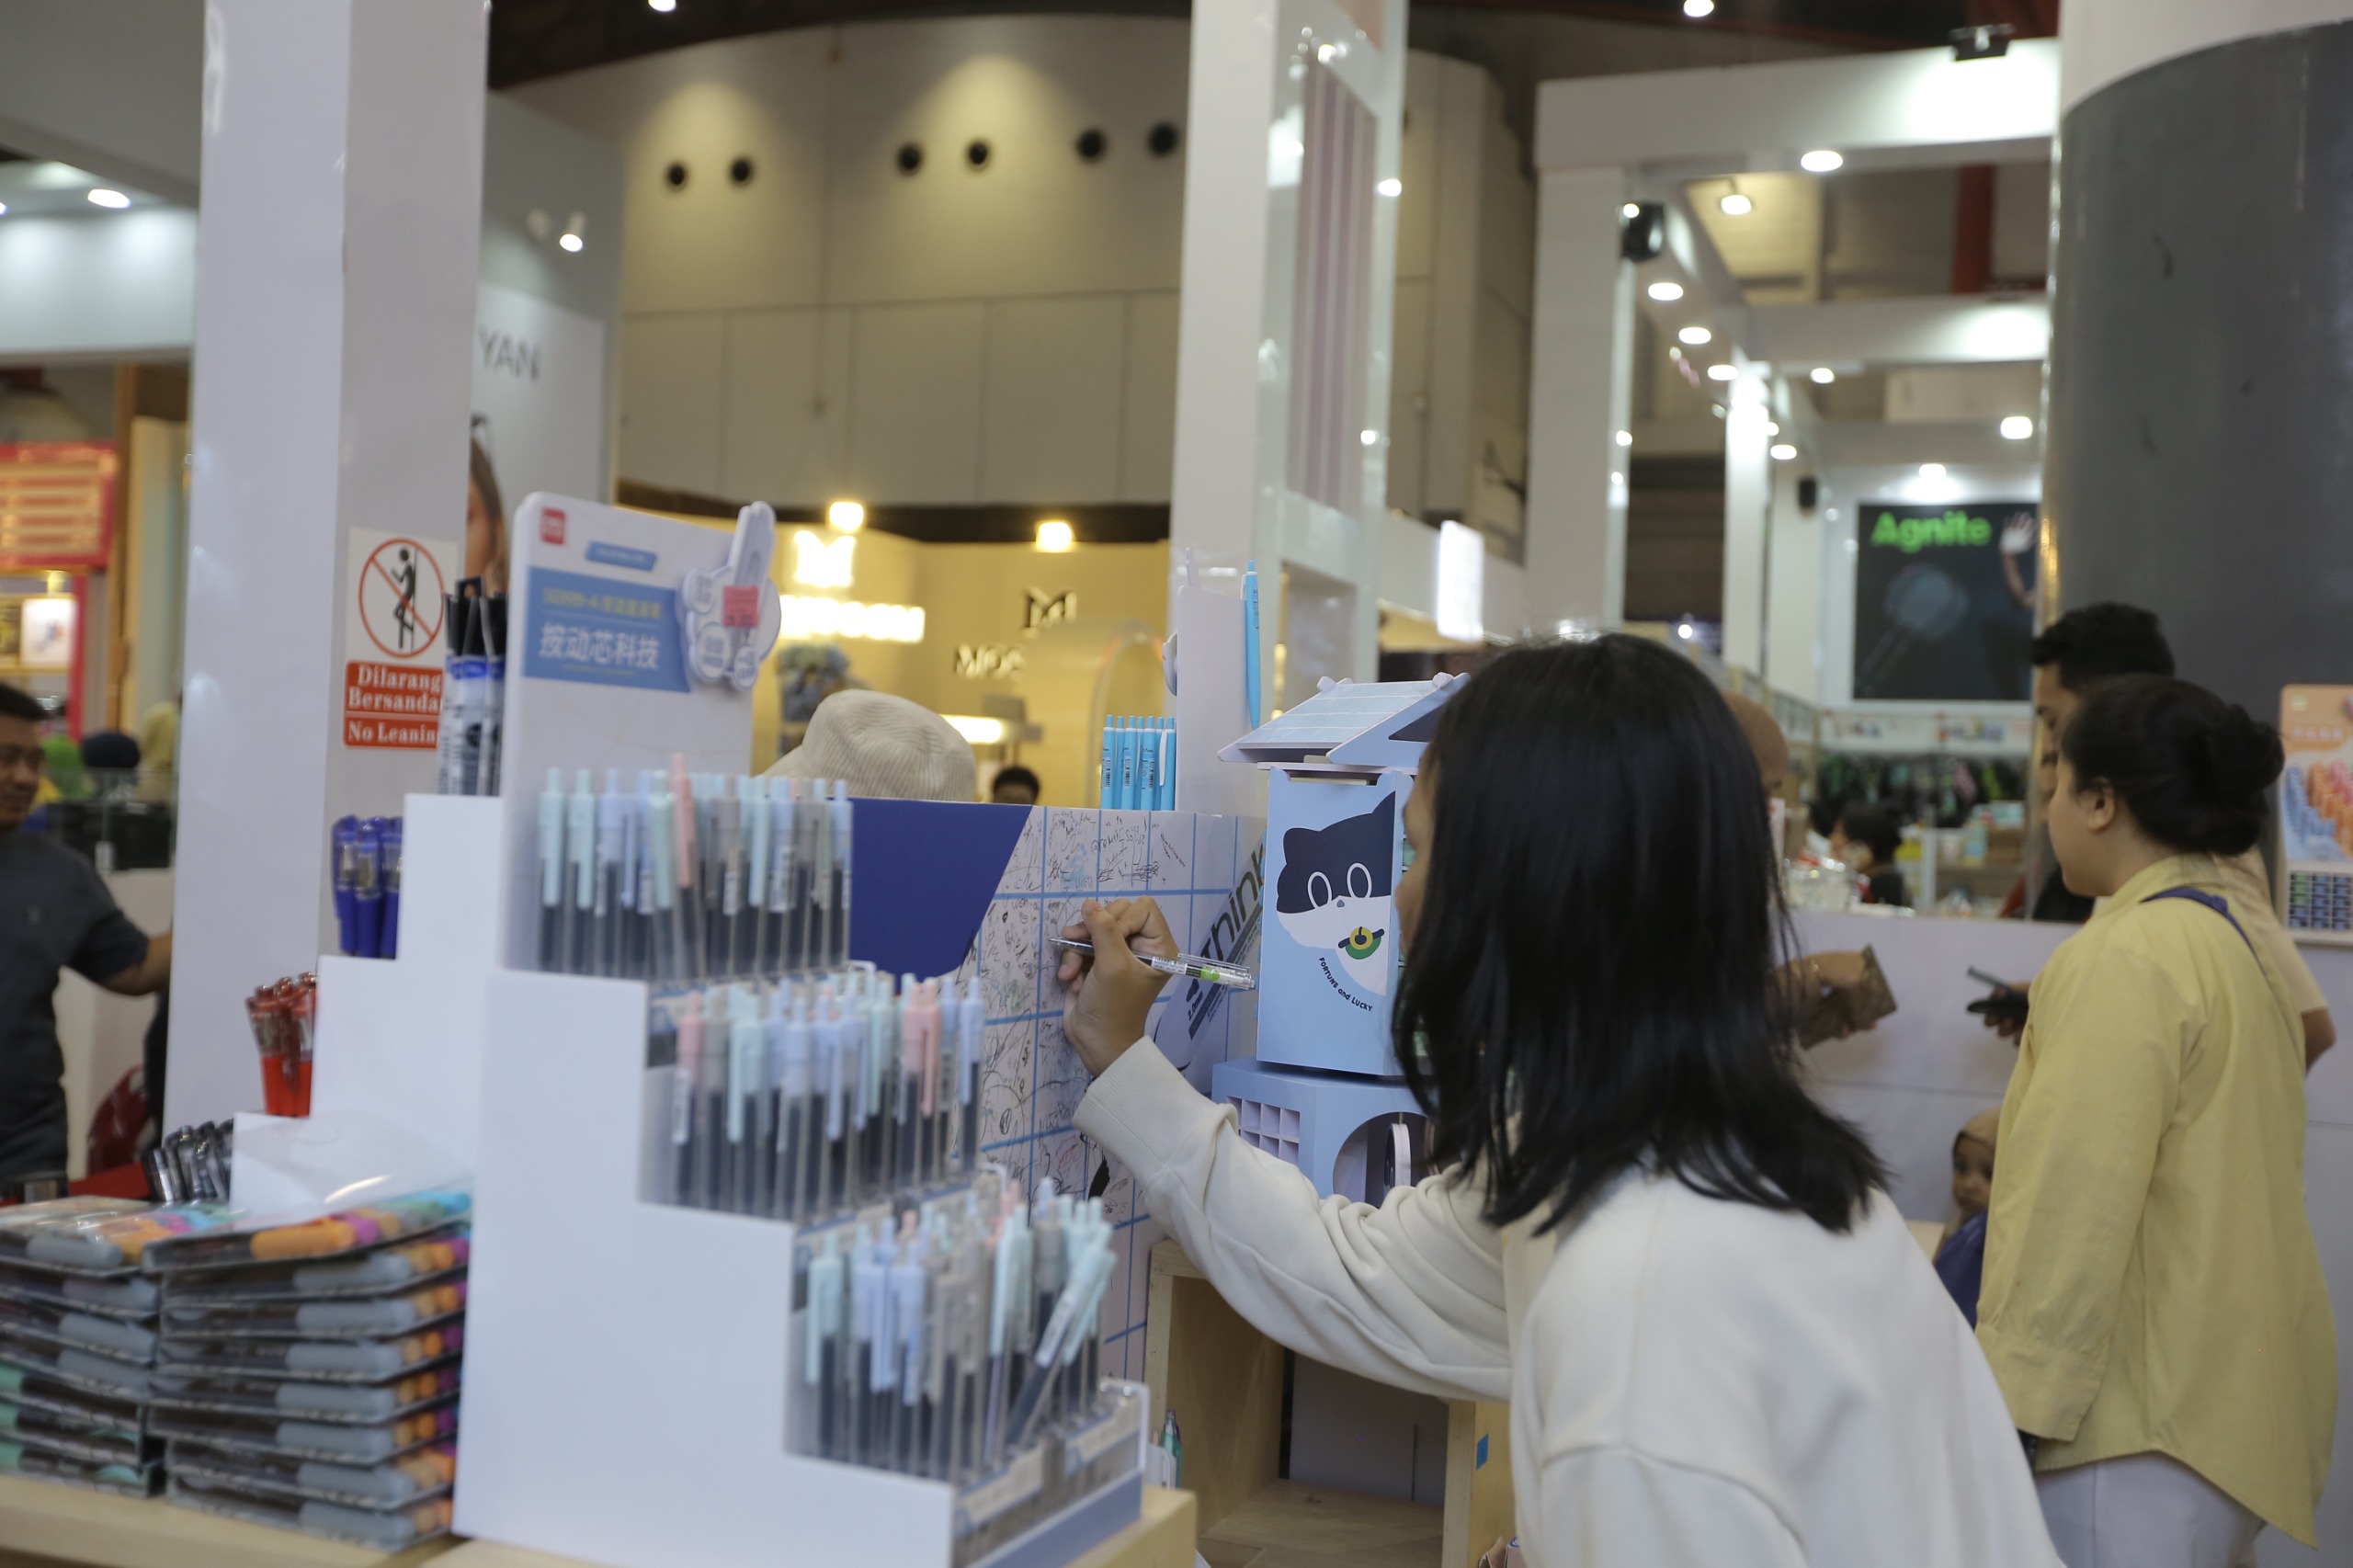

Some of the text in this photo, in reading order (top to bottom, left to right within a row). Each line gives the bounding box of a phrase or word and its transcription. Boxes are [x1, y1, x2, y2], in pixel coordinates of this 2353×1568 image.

[1871, 511, 1992, 554] Agnite
[358, 665, 441, 692] Dilarang
[348, 687, 443, 711] Bersanda
[348, 721, 438, 744] No Leanin
[1319, 957, 1373, 1011] FORTUNE and LUCKY
